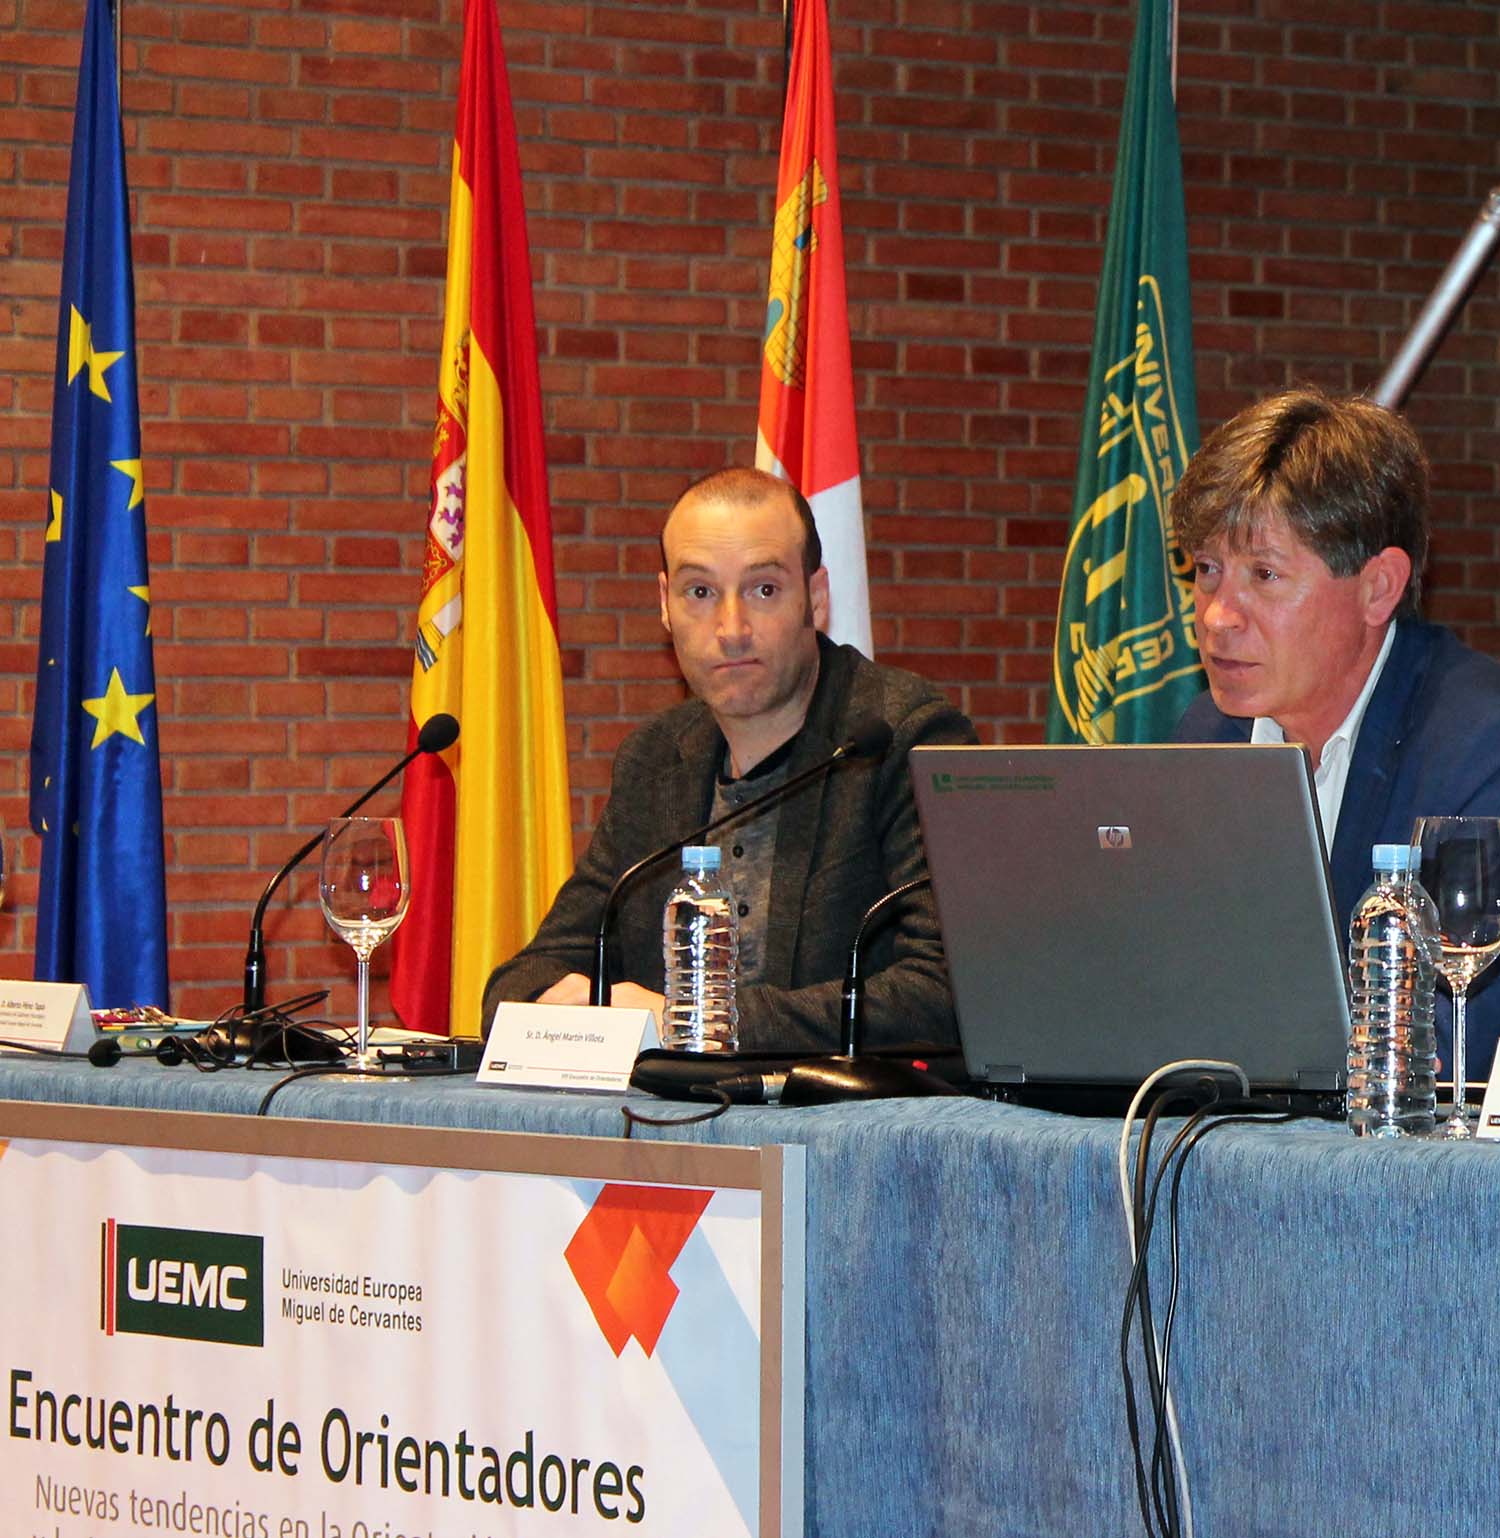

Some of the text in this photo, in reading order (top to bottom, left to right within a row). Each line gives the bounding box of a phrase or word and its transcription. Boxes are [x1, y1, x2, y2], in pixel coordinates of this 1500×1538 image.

[128, 1258, 247, 1311] UEMC
[283, 1269, 422, 1304] Universidad Europea
[282, 1298, 422, 1331] Miguel de Cervantes
[10, 1369, 645, 1523] Encuentro de Orientadores
[36, 1474, 119, 1521] Nuevas
[130, 1489, 268, 1538] tendencias
[280, 1518, 308, 1538] en
[322, 1511, 341, 1538] la
